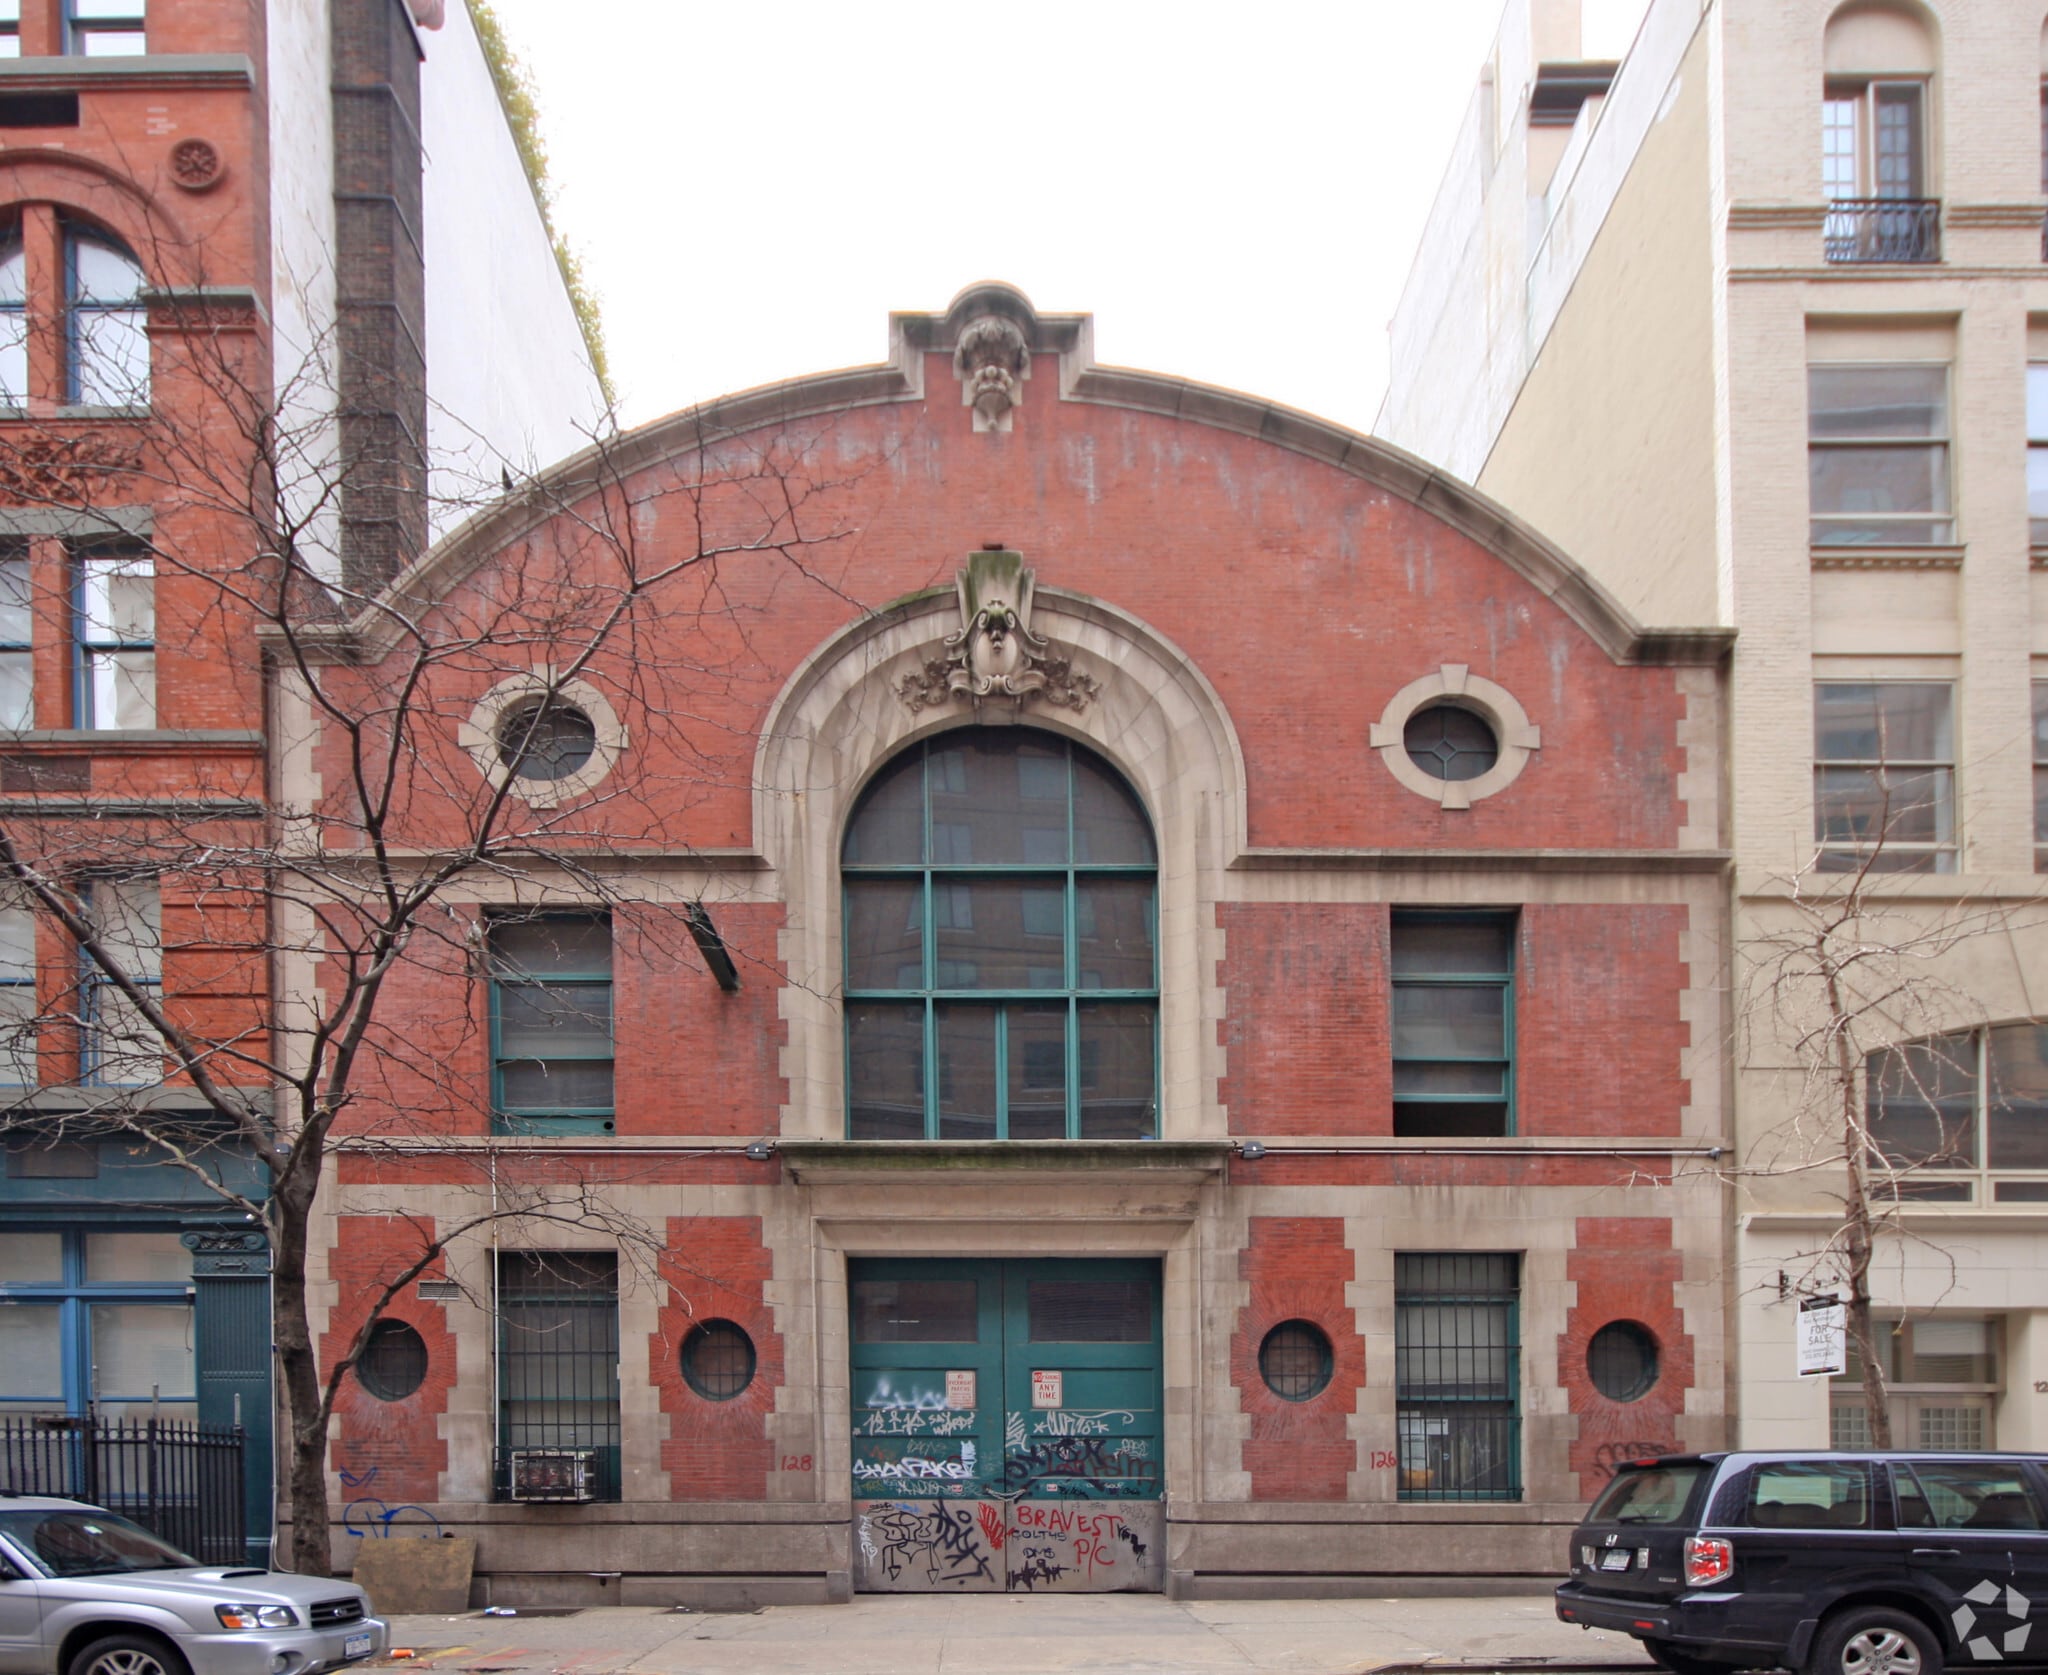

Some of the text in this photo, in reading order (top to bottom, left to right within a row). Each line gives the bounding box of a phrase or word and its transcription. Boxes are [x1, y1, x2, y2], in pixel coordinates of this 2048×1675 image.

[1810, 1324, 1827, 1335] FOR
[1808, 1333, 1831, 1345] SALE
[1039, 1383, 1055, 1391] ANY
[1038, 1391, 1057, 1400] TIME
[781, 1454, 813, 1471] 128
[1370, 1451, 1397, 1469] 126
[1016, 1505, 1124, 1539] BRAVEST
